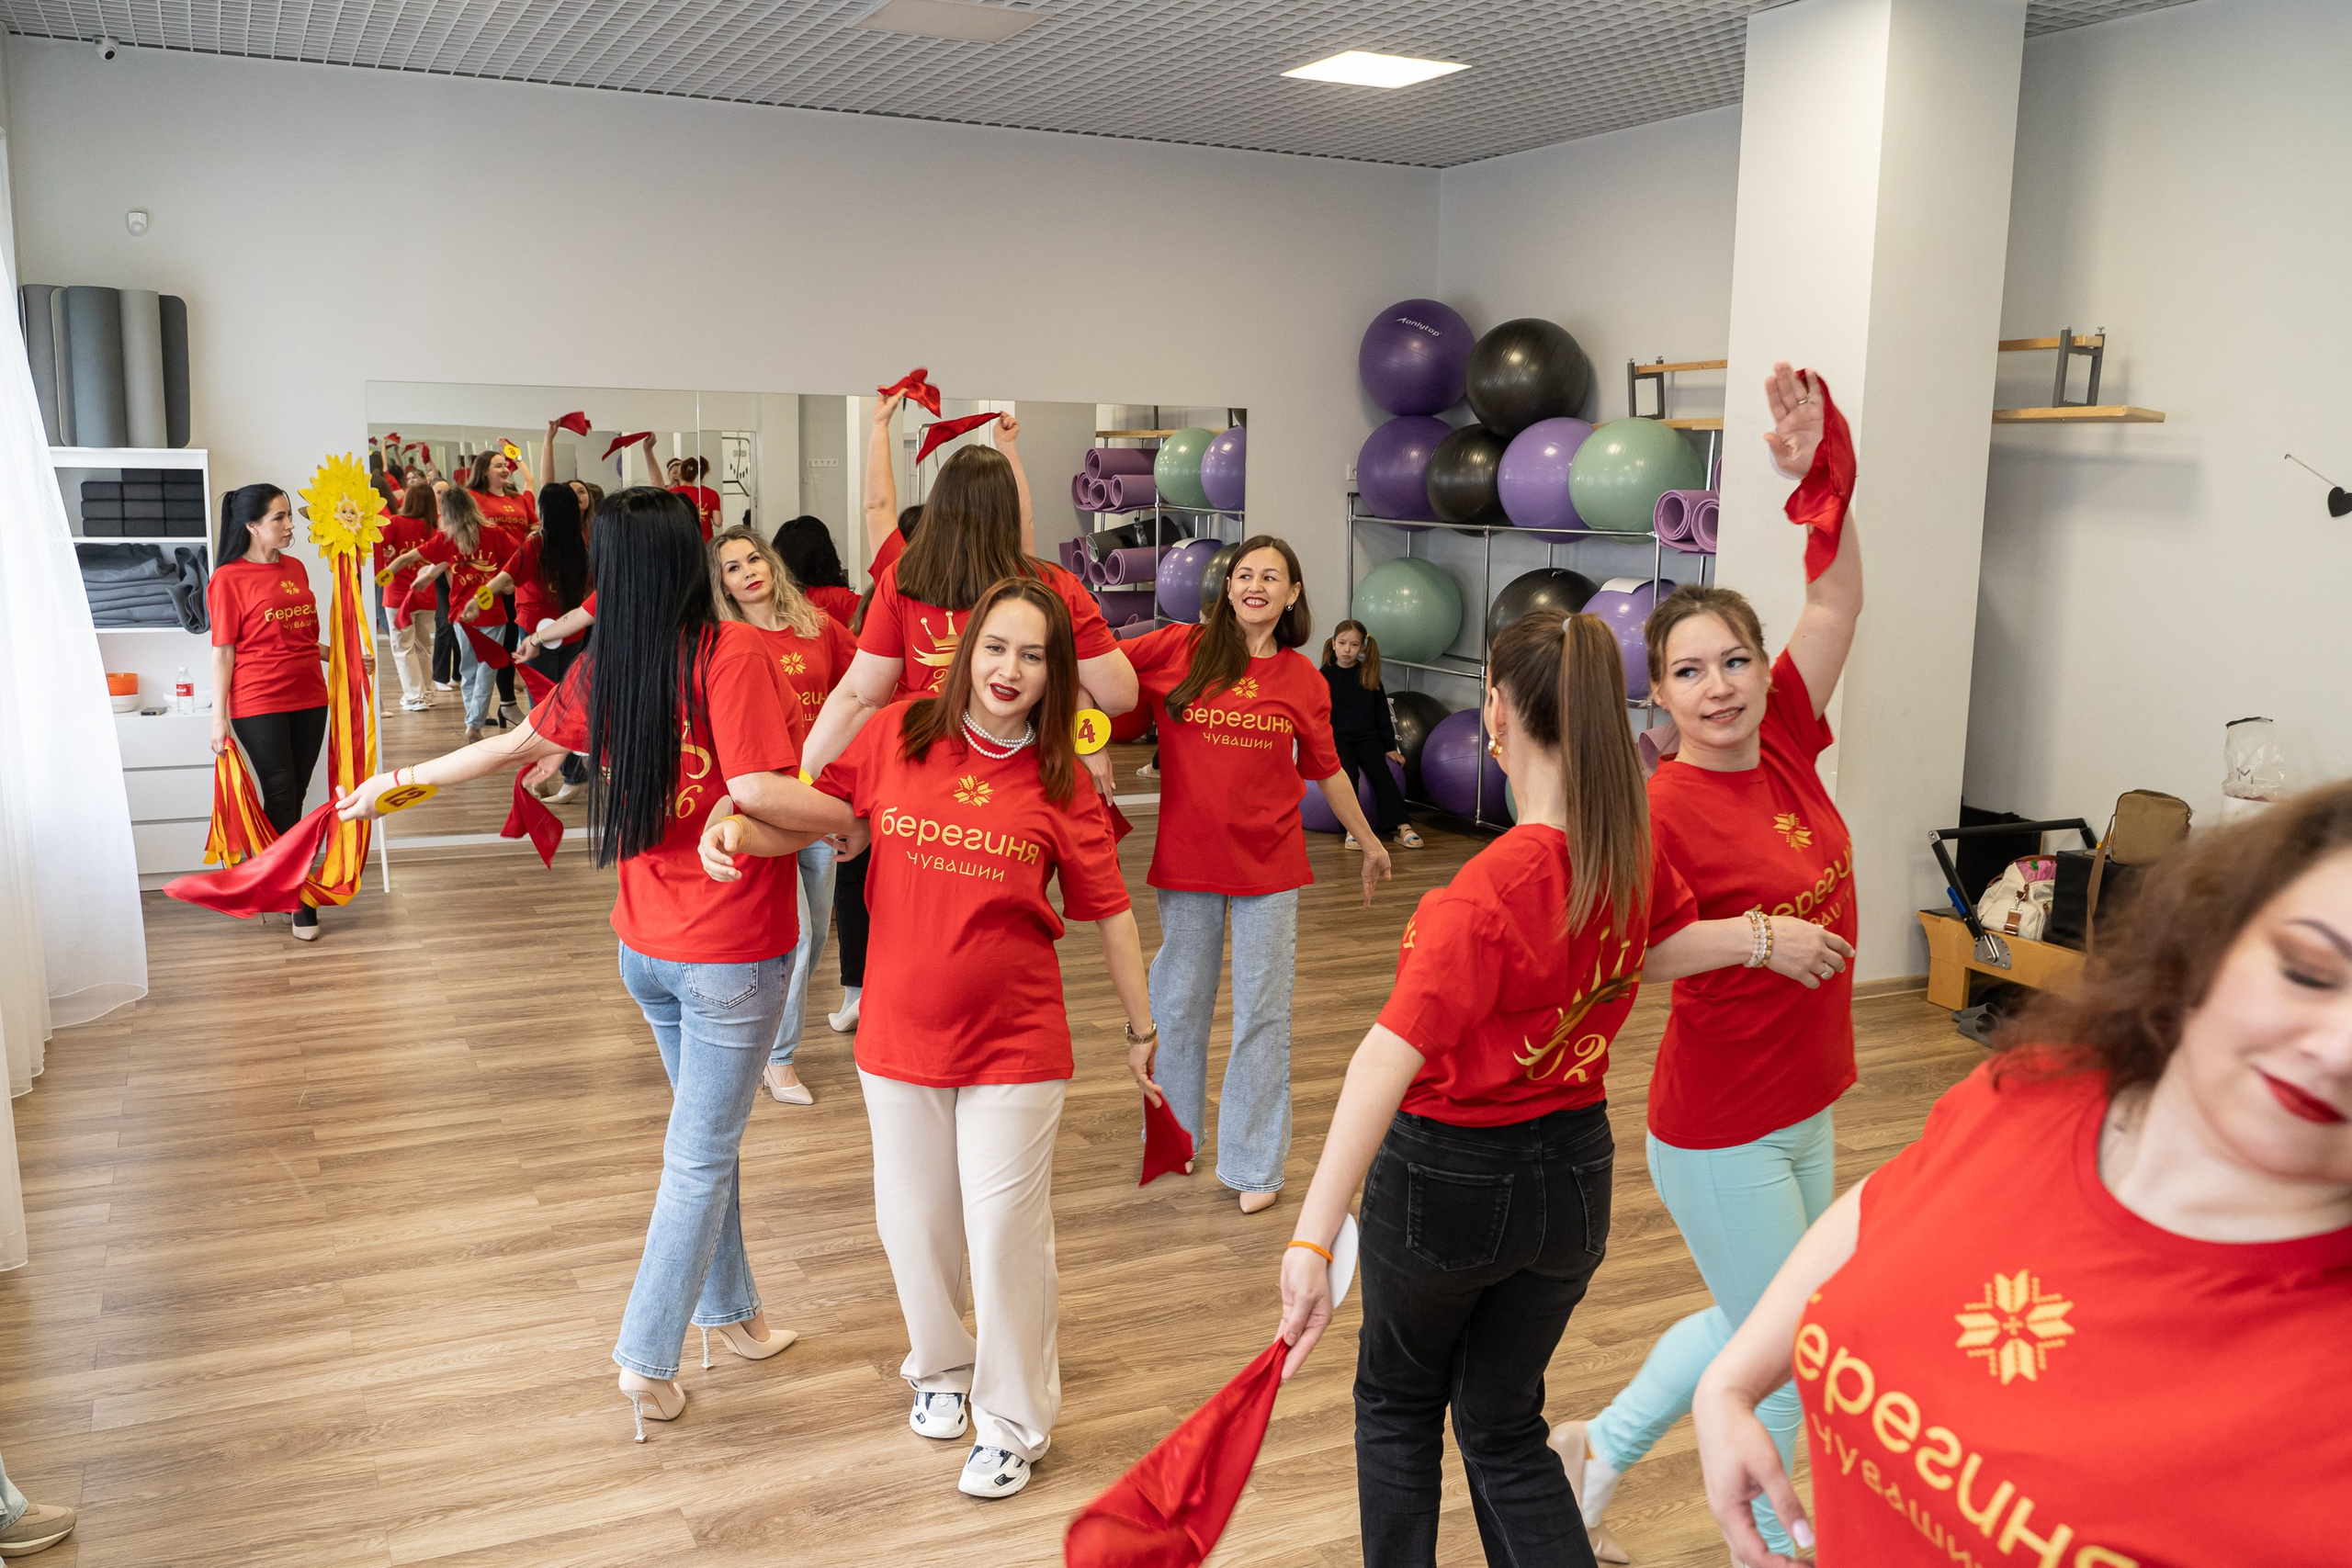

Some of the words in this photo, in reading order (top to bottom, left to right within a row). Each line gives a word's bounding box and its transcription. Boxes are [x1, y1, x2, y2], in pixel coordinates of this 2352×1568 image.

[264, 604, 317, 622] береги
[1078, 717, 1096, 744] 4
[1203, 731, 1273, 750] чувашии
[880, 807, 1040, 865] берегиня
[906, 851, 1005, 883] чувашии
[1794, 1292, 2140, 1568] ерегин
[1810, 1413, 1984, 1568] чуваши
